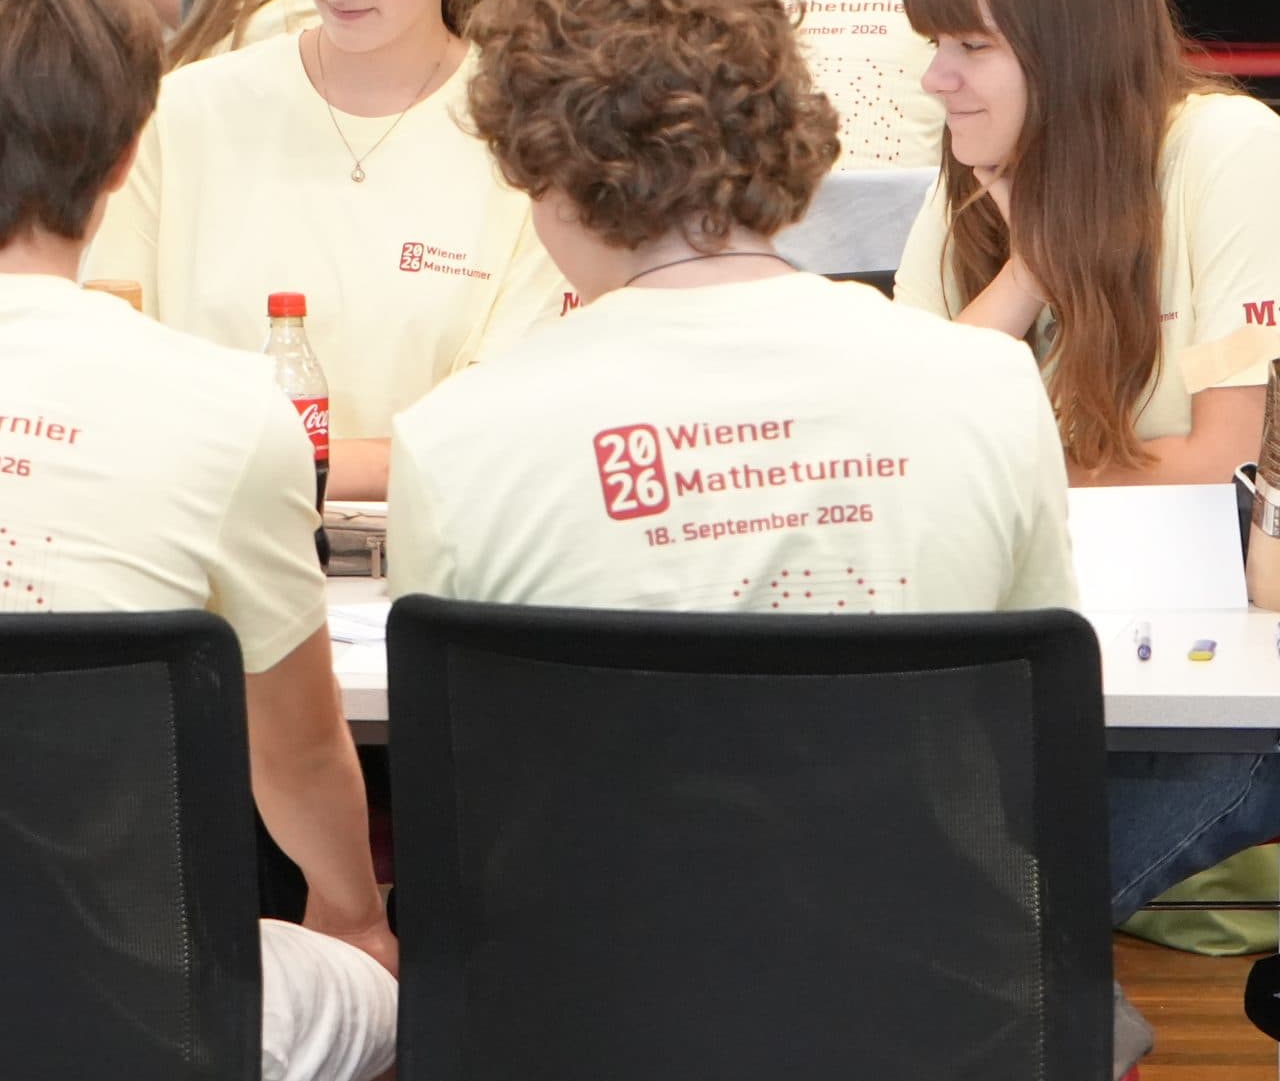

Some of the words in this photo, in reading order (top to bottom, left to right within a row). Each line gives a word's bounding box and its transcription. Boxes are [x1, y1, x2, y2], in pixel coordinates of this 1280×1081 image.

[851, 24, 888, 35] 2026
[400, 256, 421, 271] 26
[402, 243, 423, 258] 20
[426, 245, 468, 261] Wiener
[599, 428, 657, 474] 20
[666, 419, 795, 451] Wiener
[606, 468, 664, 512] 26
[673, 453, 909, 497] Matheturnier
[644, 527, 676, 547] 18.
[682, 511, 809, 541] September
[816, 504, 874, 525] 2026
